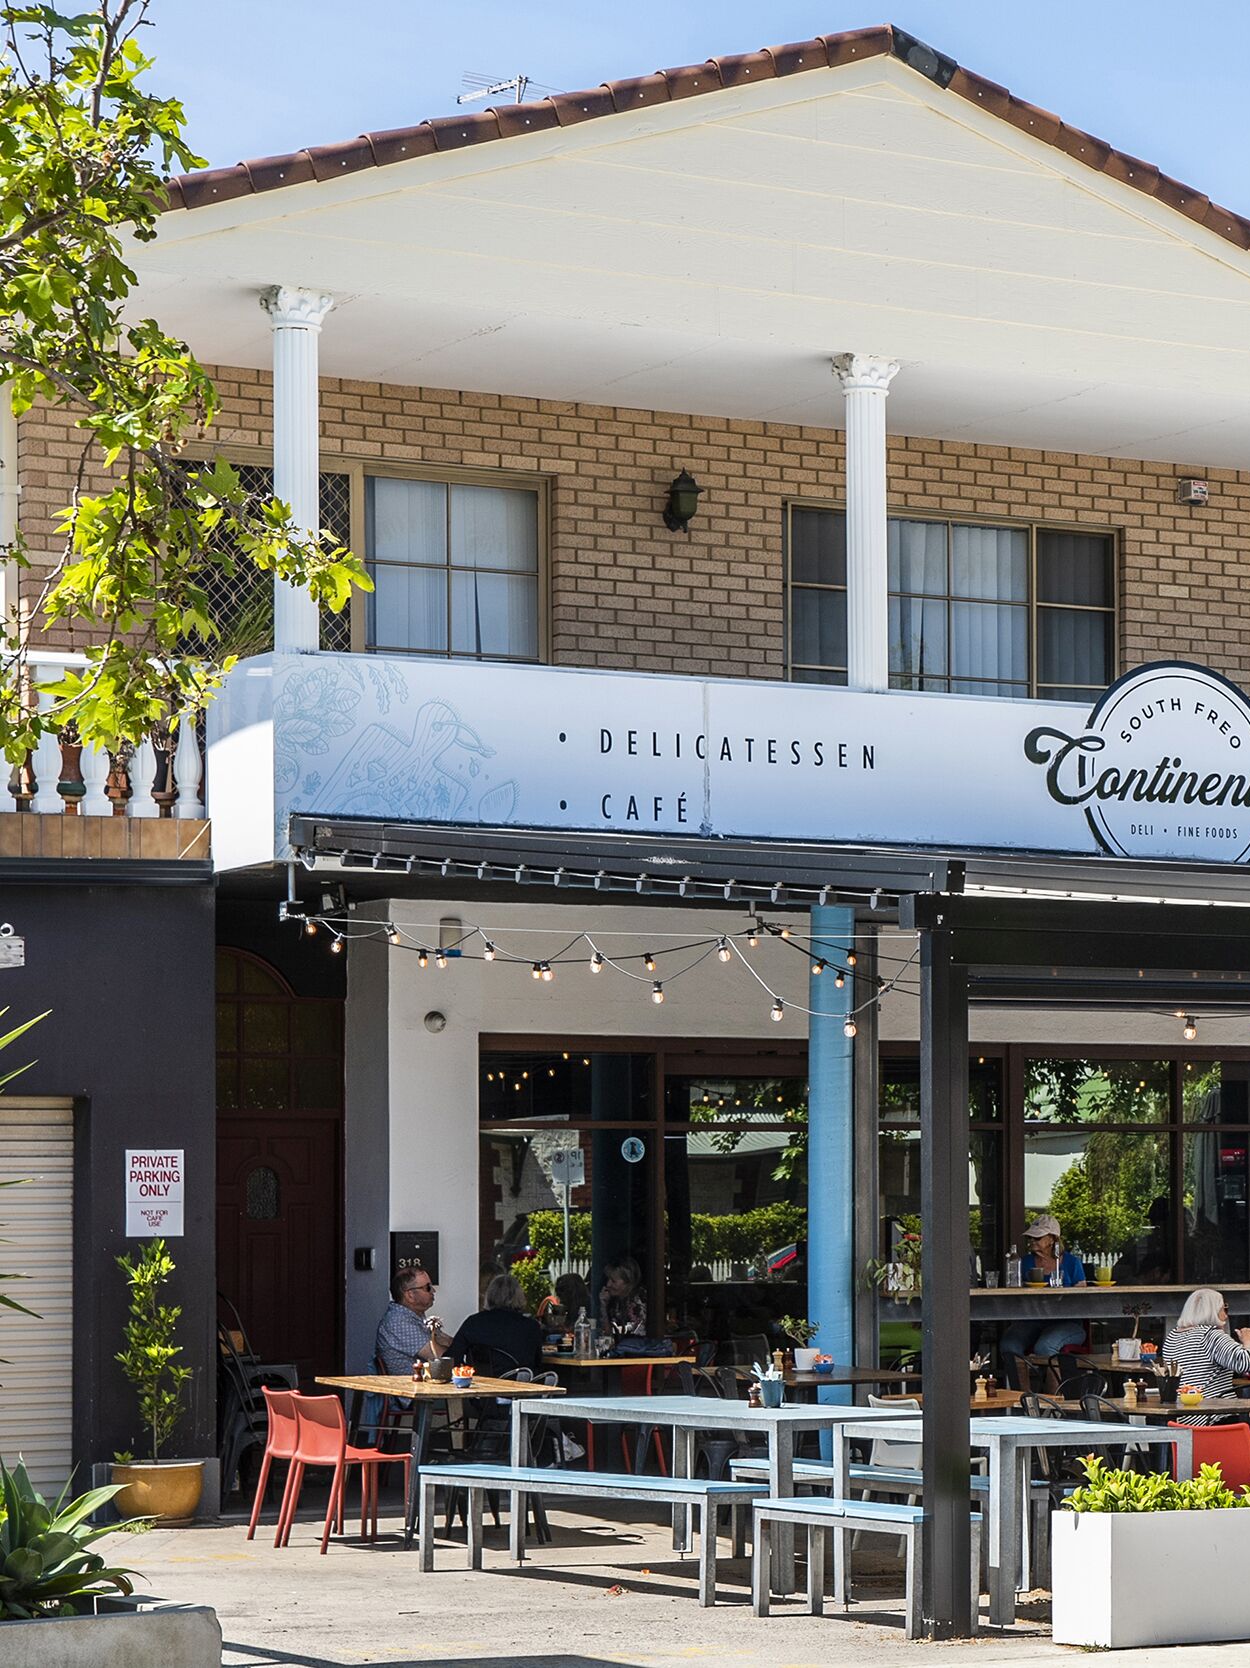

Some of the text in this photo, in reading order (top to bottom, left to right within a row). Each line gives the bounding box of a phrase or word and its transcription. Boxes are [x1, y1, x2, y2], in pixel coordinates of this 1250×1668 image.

[1120, 698, 1241, 749] SOUTH FREO
[600, 728, 875, 769] DELICATESSEN
[601, 792, 688, 822] CAFÉ
[1131, 824, 1237, 839] DELI FINE FOODS
[131, 1156, 178, 1168] PRIVATE
[130, 1171, 180, 1182] PARKING
[139, 1184, 170, 1196] ONLY
[399, 1258, 421, 1268] 318
